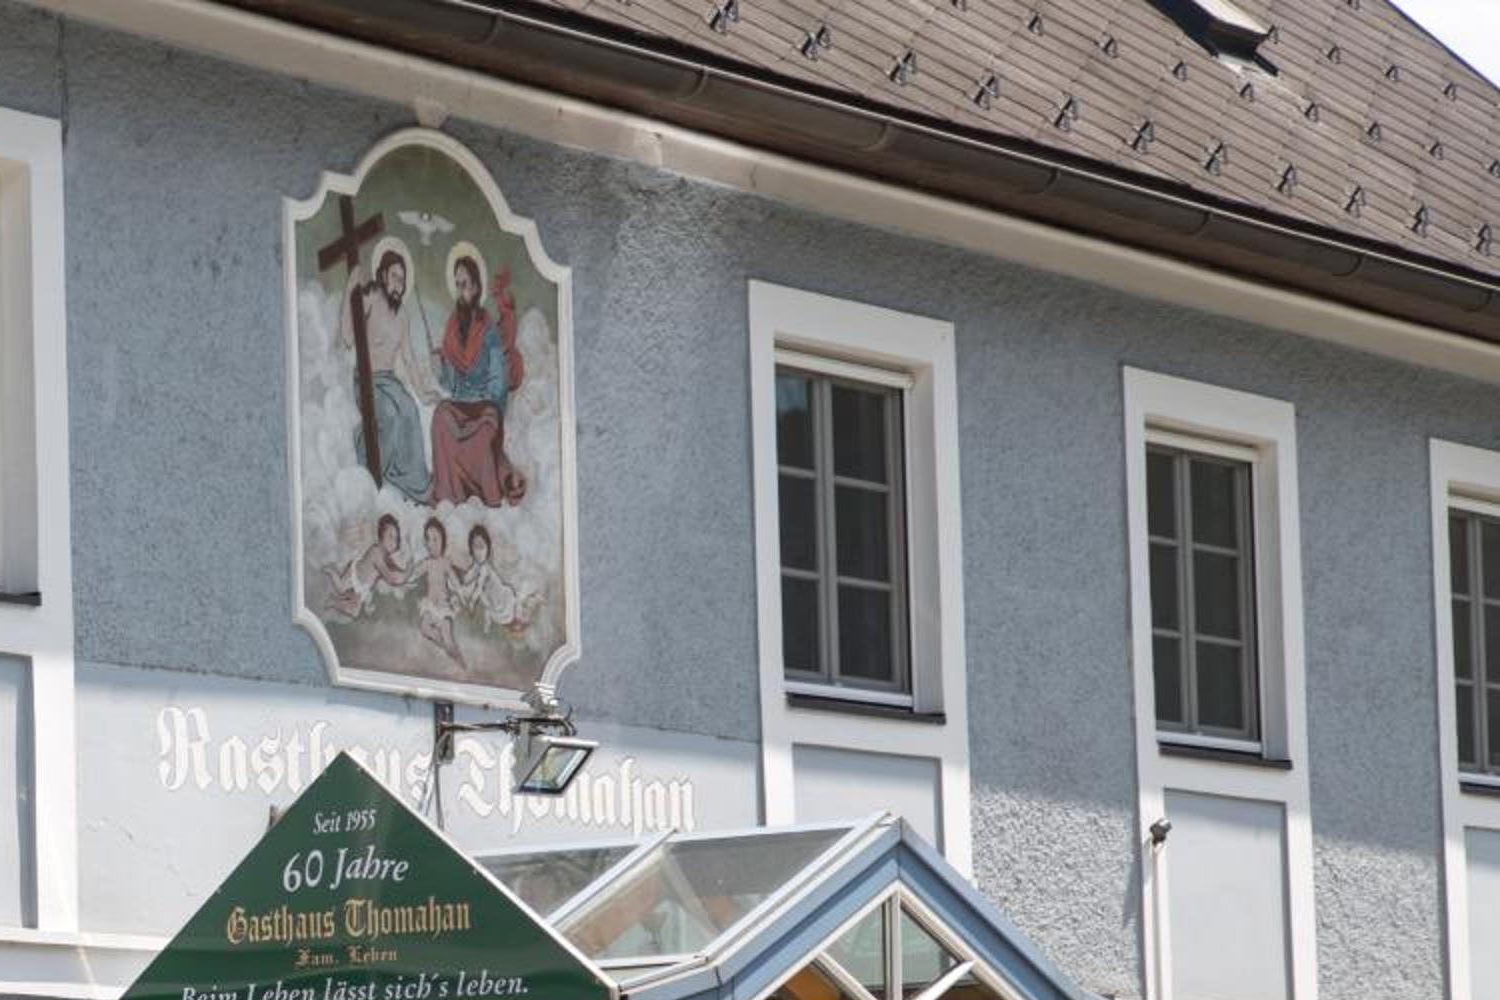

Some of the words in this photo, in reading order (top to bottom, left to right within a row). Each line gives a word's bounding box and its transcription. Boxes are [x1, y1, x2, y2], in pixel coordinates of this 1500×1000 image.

[313, 812, 341, 834] Seit
[345, 808, 377, 831] 1955
[283, 850, 324, 893] 60
[329, 845, 410, 890] Jahre
[227, 904, 335, 944] Gasthaus
[344, 895, 472, 939] Thomahan
[295, 948, 339, 967] Fam.
[348, 945, 398, 965] Leben
[457, 969, 530, 997] leben.
